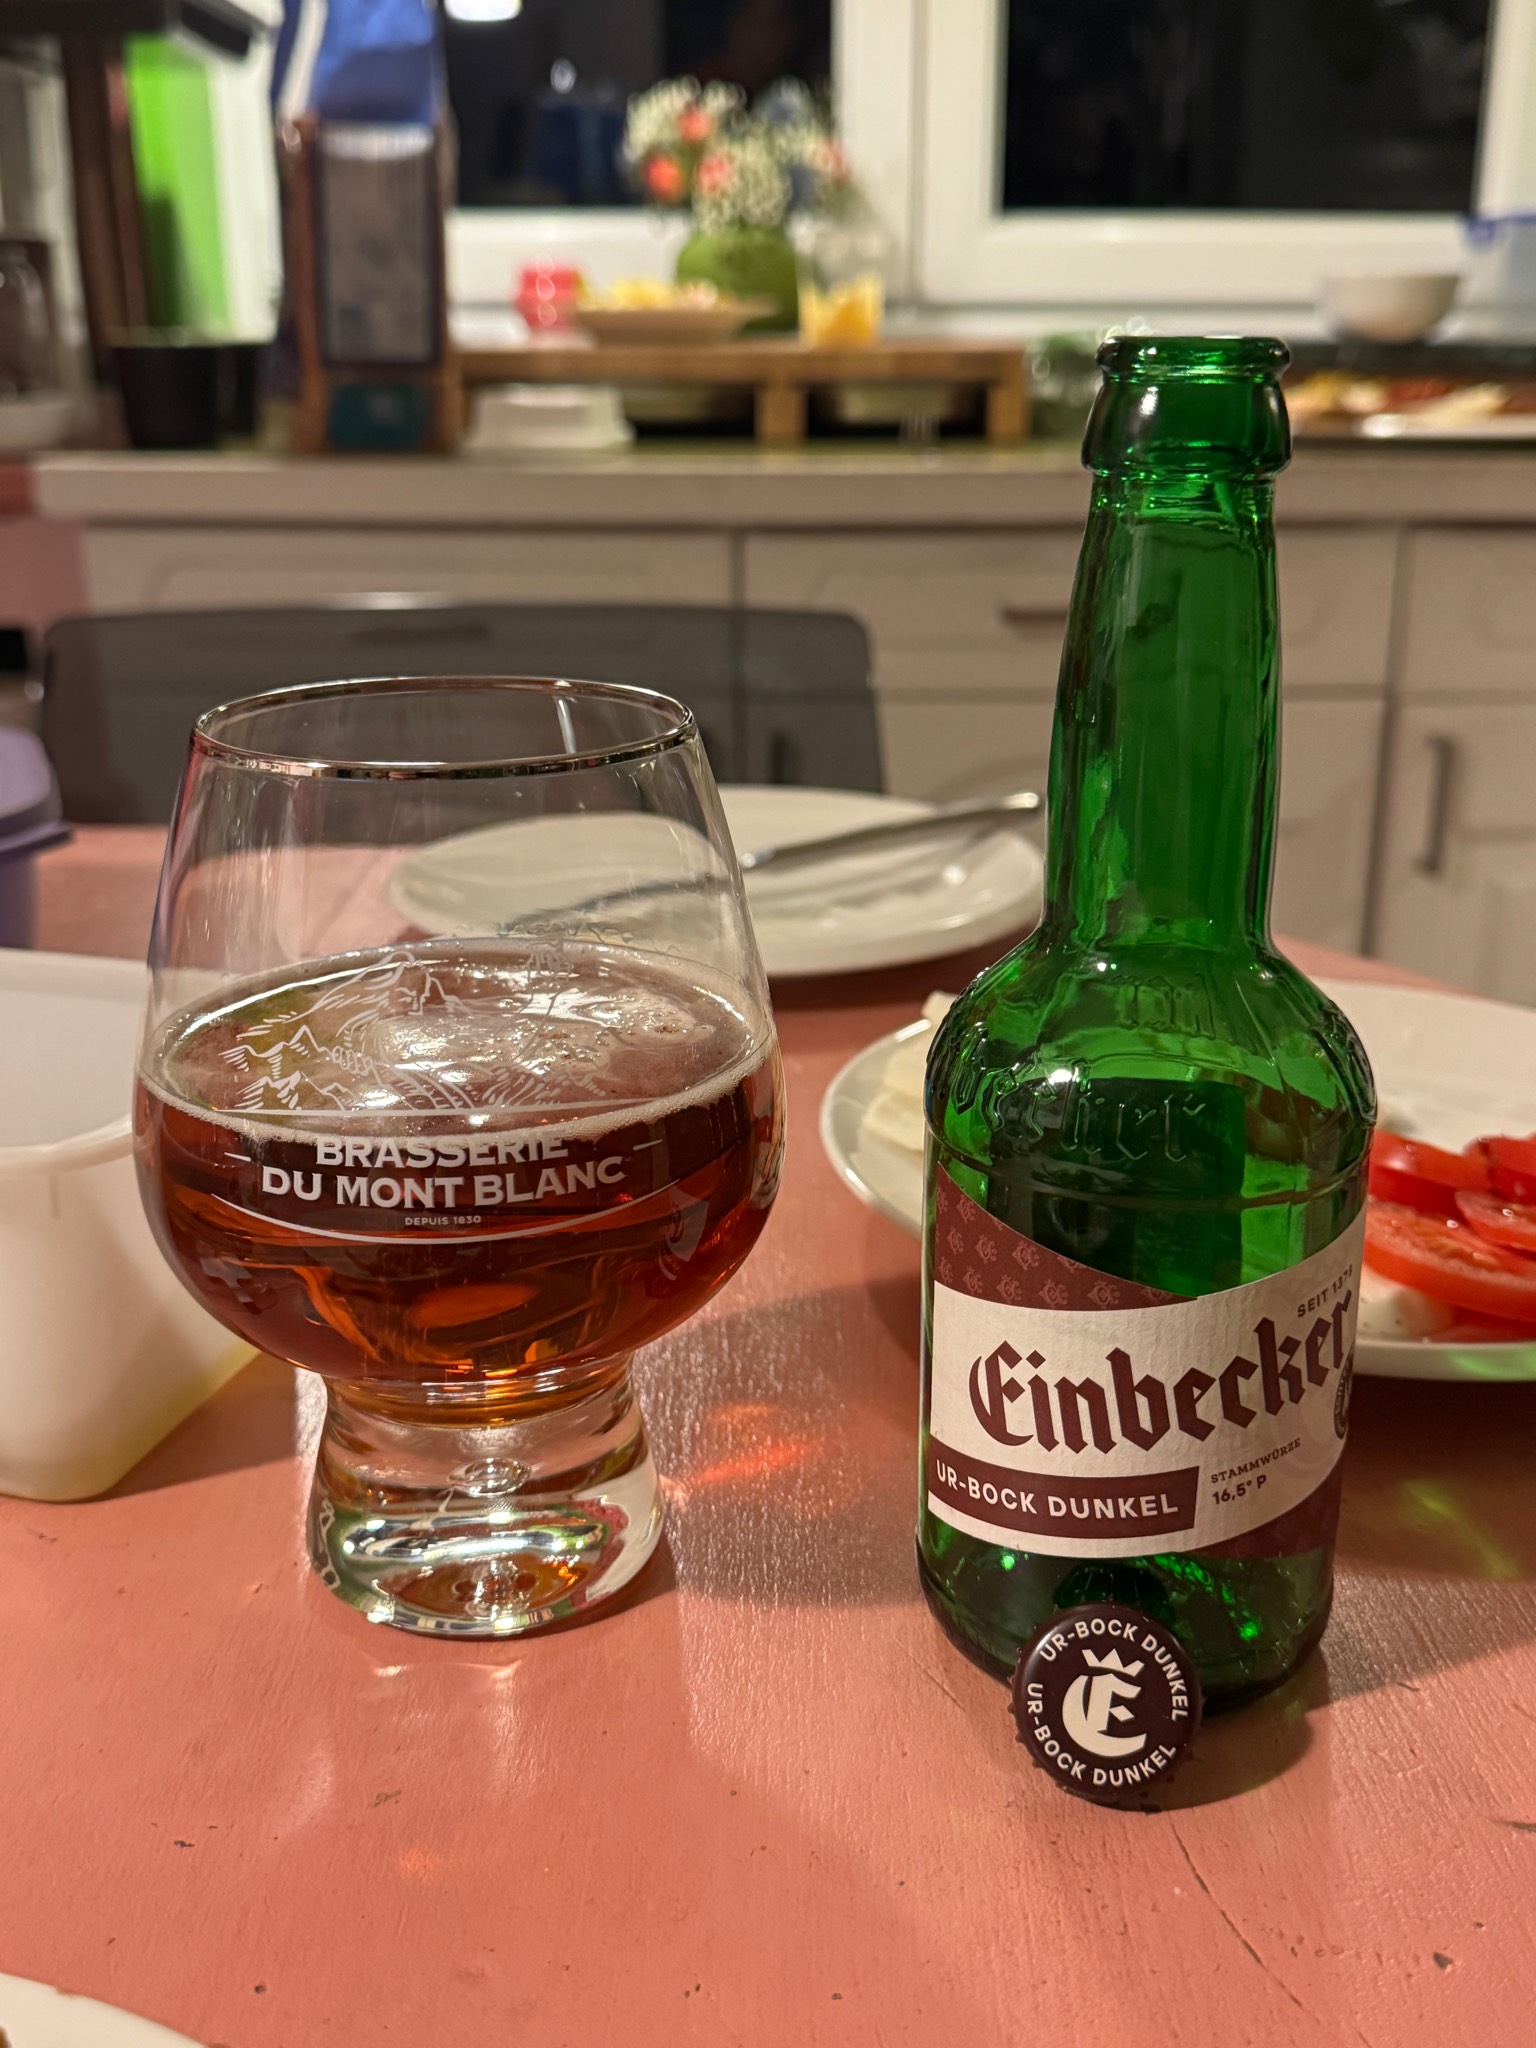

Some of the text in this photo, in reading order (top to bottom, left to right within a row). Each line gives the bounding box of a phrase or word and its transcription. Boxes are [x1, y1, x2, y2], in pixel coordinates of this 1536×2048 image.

[316, 1130, 569, 1169] BRASSERIE
[262, 1155, 628, 1209] DU MONT BLANC
[404, 1215, 482, 1227] DEPUIS 1830
[1297, 1288, 1328, 1318] SEIT
[969, 1289, 1353, 1455] Einbecker
[1210, 1437, 1301, 1484] STAMMWÜRZE
[1256, 1474, 1267, 1489] P
[936, 1458, 1179, 1520] UR-BOCK DUNKEL
[1039, 1618, 1190, 1723] UR-BOCK DUNKEL
[1027, 1682, 1177, 1787] UR-BOCK DUNKEL
